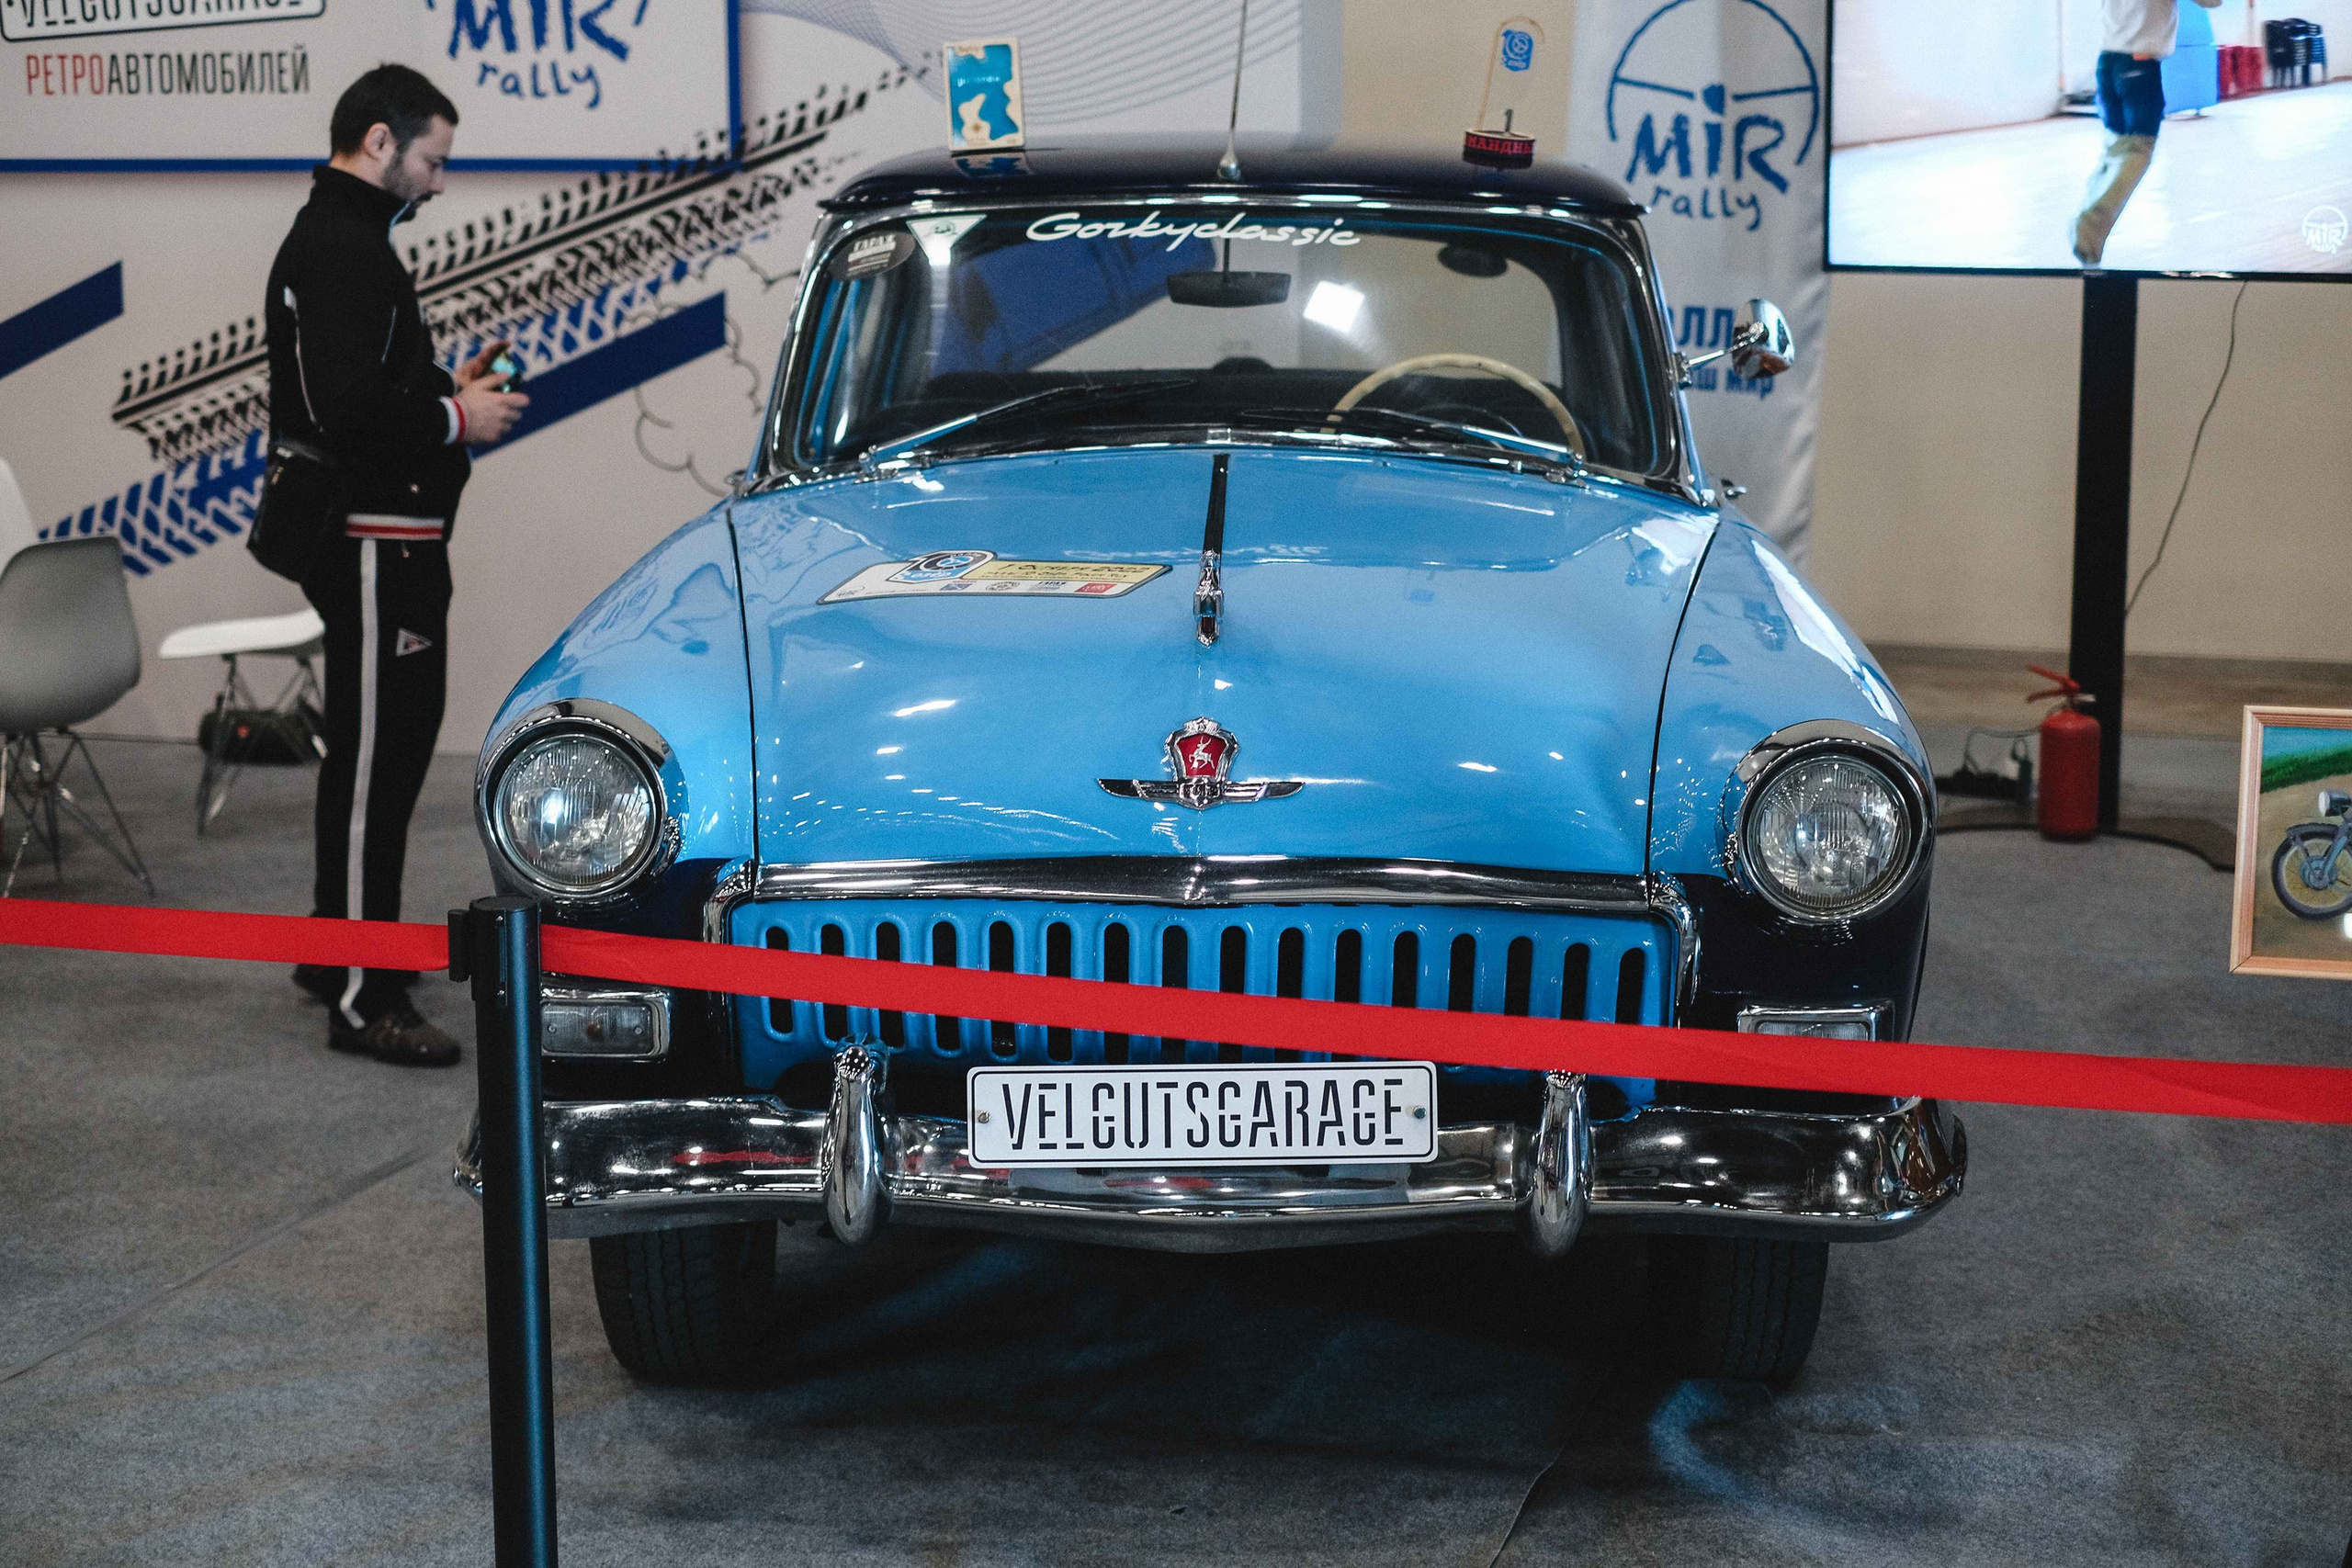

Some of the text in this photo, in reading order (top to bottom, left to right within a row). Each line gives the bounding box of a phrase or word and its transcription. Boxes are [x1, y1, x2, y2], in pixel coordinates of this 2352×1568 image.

[26, 45, 311, 96] РЕТРОАВТОМОБИЛЕЙ
[477, 62, 602, 109] rally
[1650, 186, 1762, 231] rally
[1001, 1078, 1404, 1151] VELGUTSGARAGE
